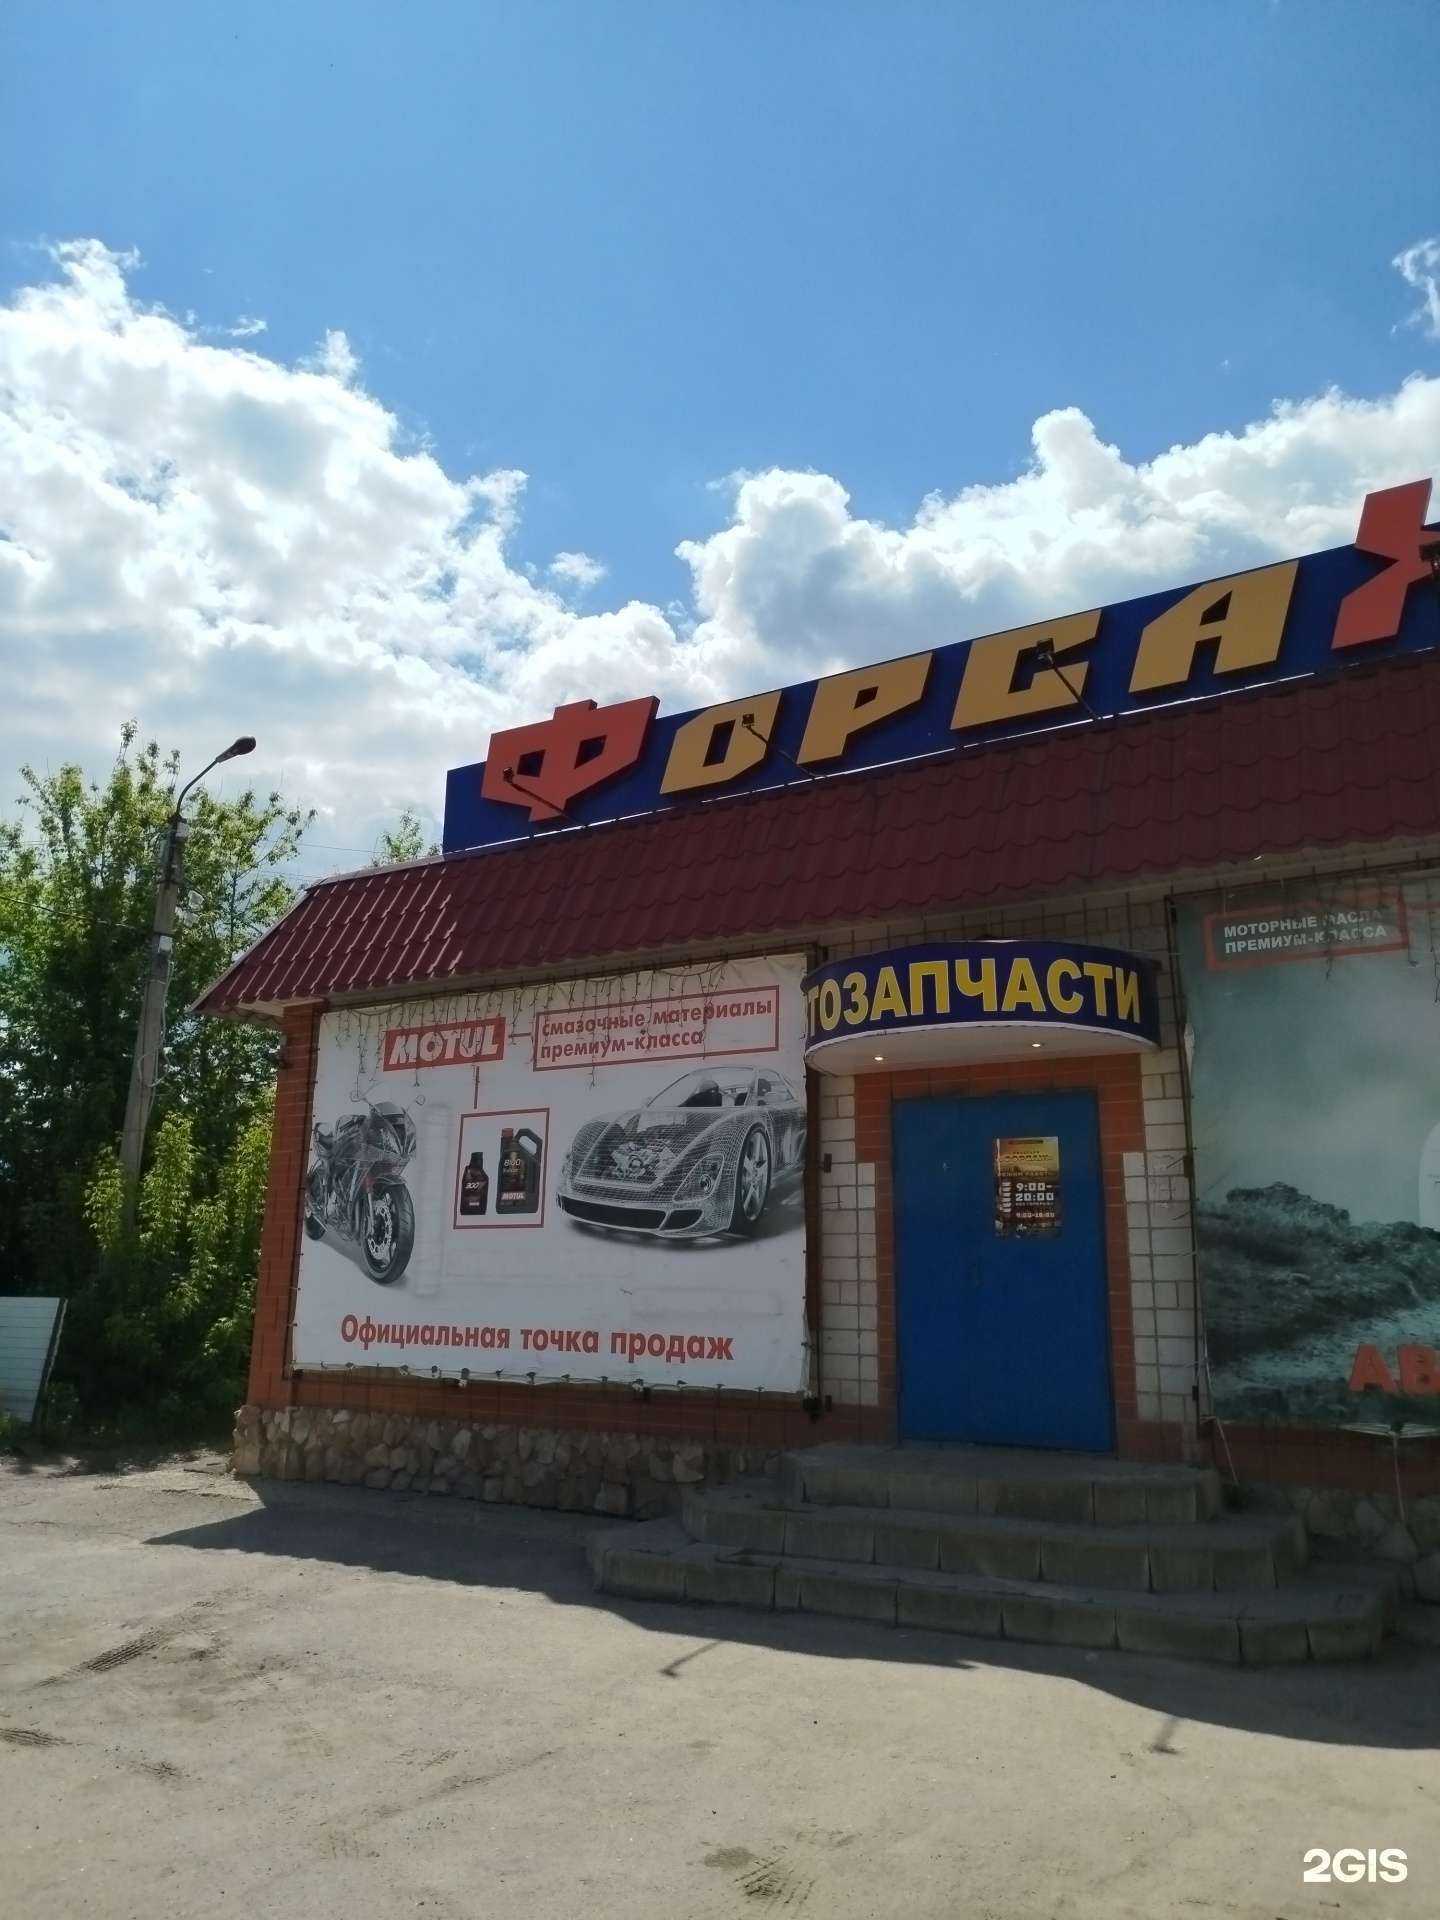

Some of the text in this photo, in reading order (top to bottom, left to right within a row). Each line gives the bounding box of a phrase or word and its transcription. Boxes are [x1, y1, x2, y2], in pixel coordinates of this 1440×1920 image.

[1224, 915, 1318, 938] МОТОРНЫЕ
[541, 998, 773, 1037] смазочные материалы
[387, 1022, 500, 1067] MOTUL
[540, 1030, 703, 1062] премиум-класса
[340, 1314, 735, 1363] Официальная точка продаж
